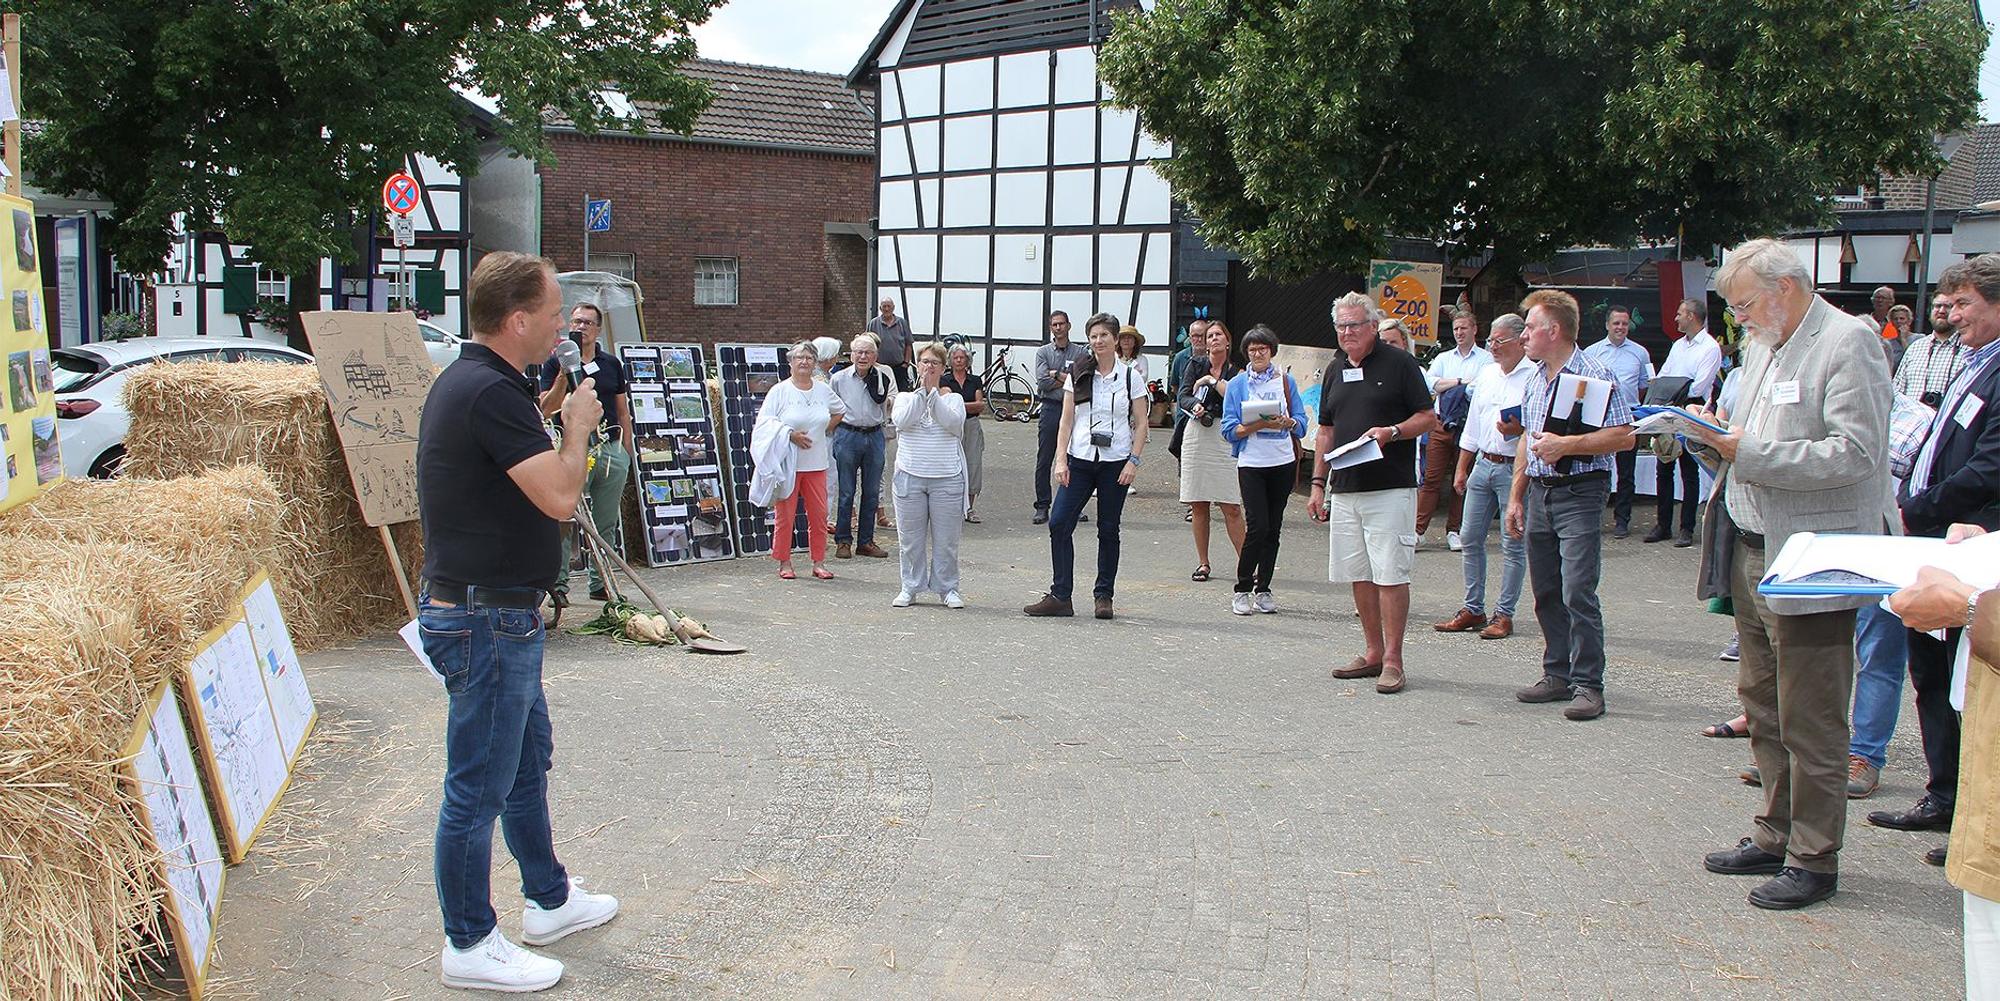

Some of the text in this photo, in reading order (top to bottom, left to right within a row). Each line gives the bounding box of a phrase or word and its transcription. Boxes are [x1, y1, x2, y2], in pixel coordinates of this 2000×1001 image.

[1384, 285, 1398, 298] Dr
[1394, 300, 1427, 317] ZOO
[1408, 321, 1429, 337] ütt
